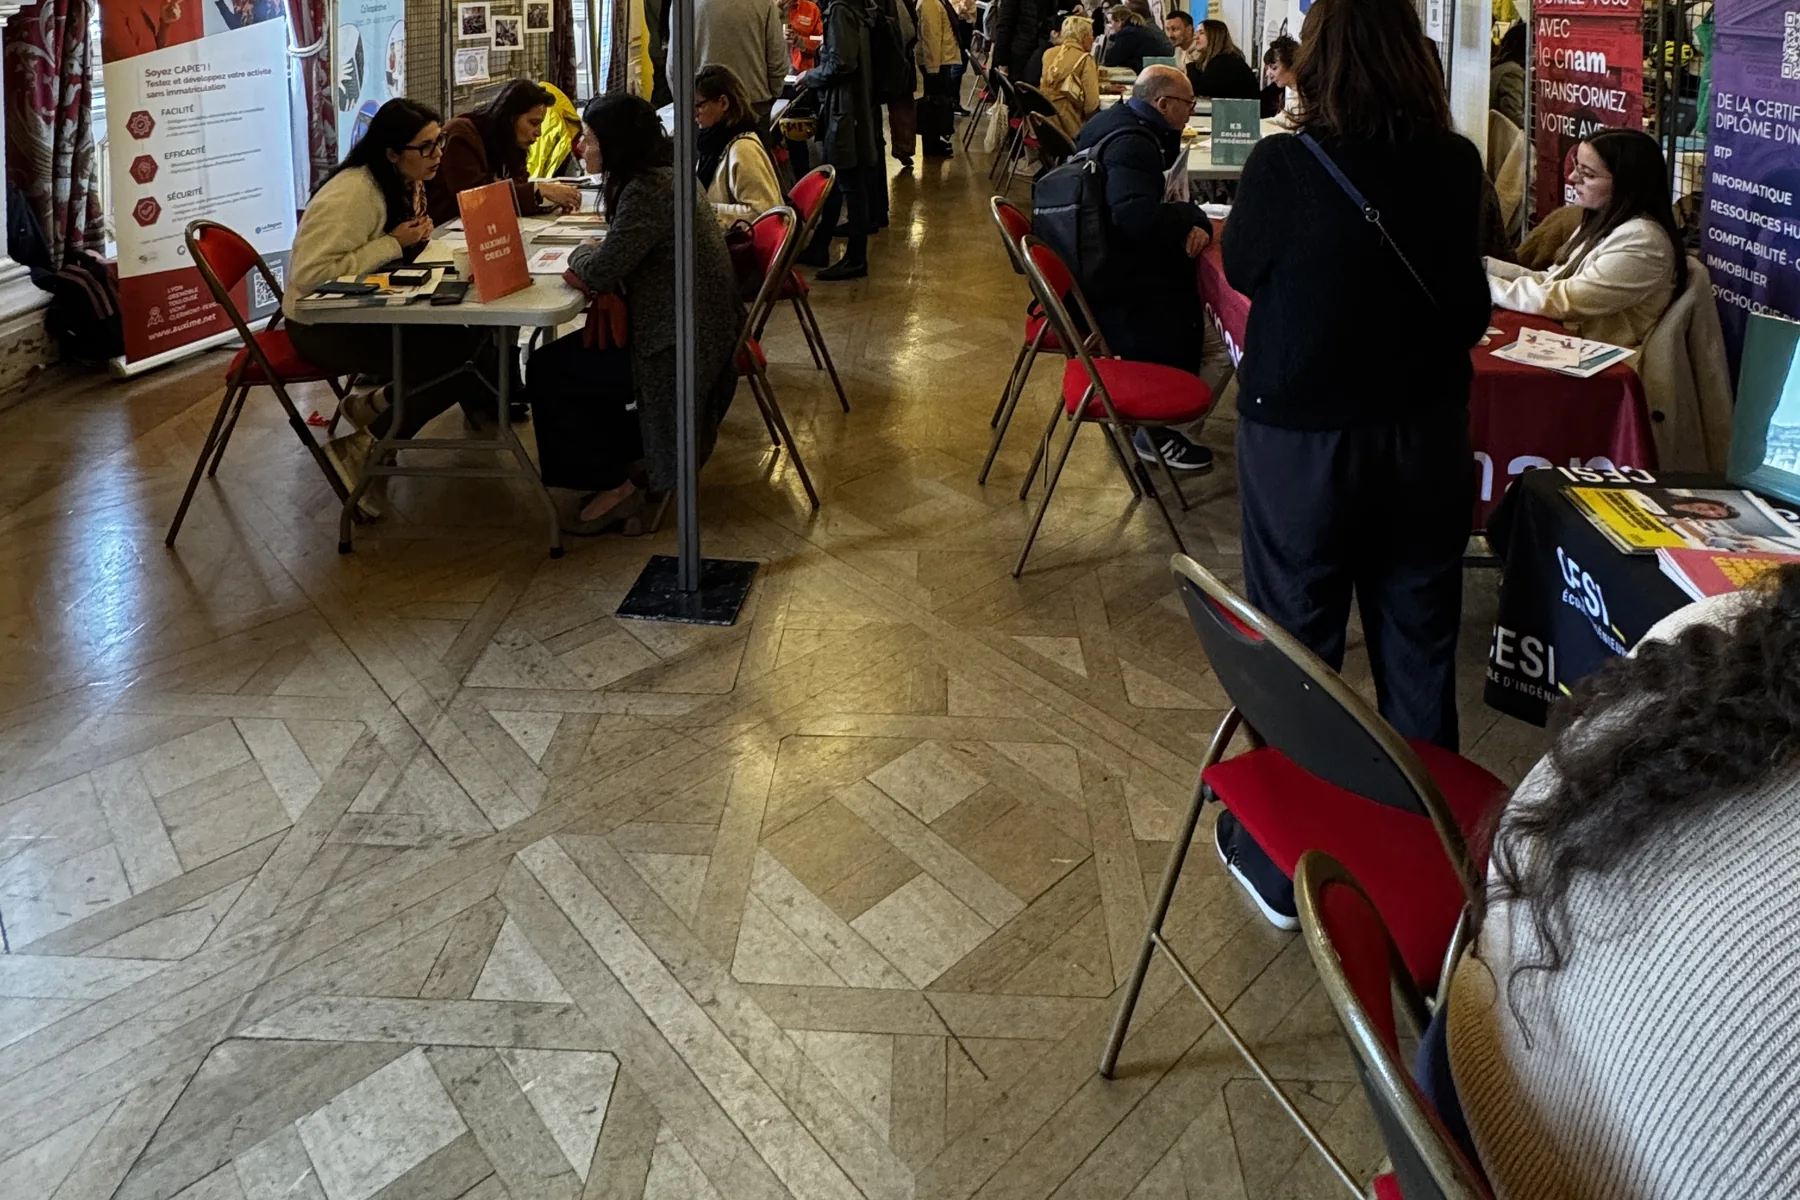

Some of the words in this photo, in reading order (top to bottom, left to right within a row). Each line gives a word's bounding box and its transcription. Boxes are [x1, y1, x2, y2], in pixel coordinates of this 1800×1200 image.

[1538, 17, 1571, 38] AVEC
[1539, 41, 1551, 67] le
[1554, 48, 1610, 79] cnam,
[145, 68, 172, 79] Soyez
[173, 76, 182, 85] et
[166, 83, 226, 96] immatriculation
[1540, 78, 1627, 113] TRANSFORMEZ
[161, 104, 194, 116] FACILITÉ
[1717, 92, 1733, 110] DE
[1736, 96, 1752, 114] LA
[1540, 111, 1576, 137] VOTRE
[1716, 112, 1772, 139] DIPLÔME
[164, 145, 206, 160] EFFICACITÉ
[1714, 145, 1732, 159] BTP
[167, 187, 203, 201] SÉCURITÉ
[1712, 172, 1793, 206] INFORMATIQUE
[1711, 199, 1782, 233] RESSOURCES
[1709, 227, 1787, 266] COMPTABILITÉ
[1707, 254, 1768, 288] IMMOBILIER
[1711, 284, 1780, 316] SYCHOLOGIE
[148, 312, 217, 341] www.auxime.net
